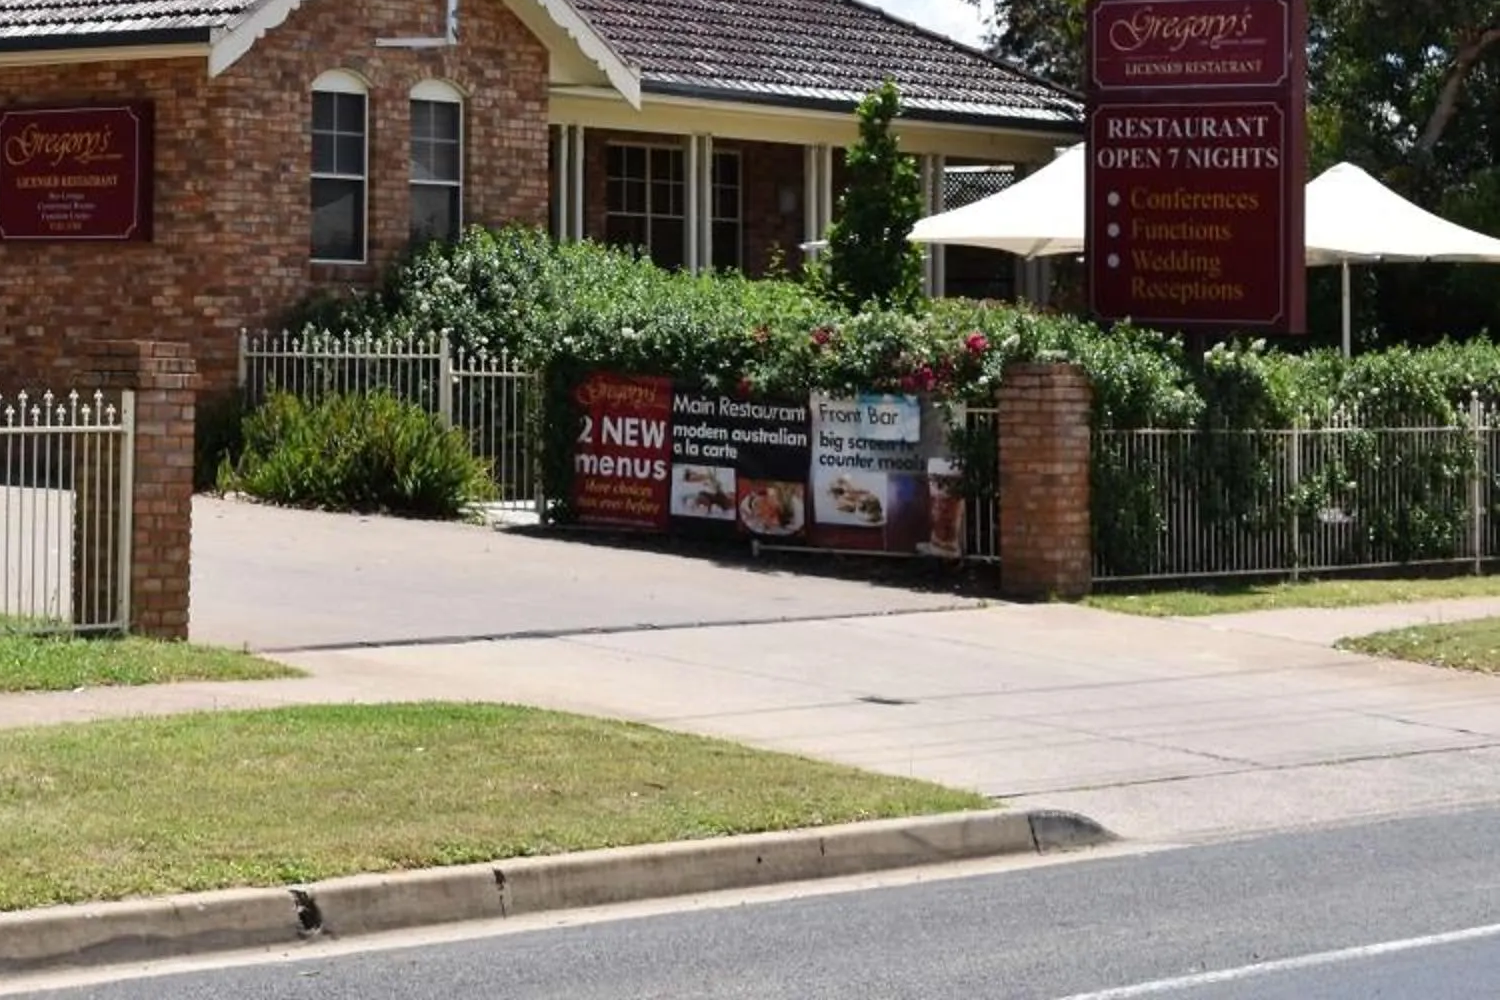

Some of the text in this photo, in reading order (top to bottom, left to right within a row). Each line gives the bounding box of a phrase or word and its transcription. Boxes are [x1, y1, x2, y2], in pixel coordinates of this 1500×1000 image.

[1109, 6, 1254, 52] Gregory's
[1125, 61, 1183, 76] LICENSED
[1185, 59, 1263, 75] RESTAURANT
[1107, 116, 1269, 140] RESTAURANT
[5, 122, 114, 167] Gregory's
[1097, 147, 1280, 170] OPEN 7 NIGHTS
[1130, 186, 1260, 210] Conferences
[1131, 217, 1233, 241] Functions
[1131, 249, 1222, 279] Wedding
[1131, 276, 1245, 305] Receptions
[673, 393, 806, 422] Main Restaurant
[819, 403, 899, 425] Front Bar
[577, 414, 667, 449] 2 NEW
[673, 421, 808, 447] modern australian
[819, 431, 844, 452] big
[847, 435, 897, 451] screen
[673, 438, 739, 459] a la carte
[574, 453, 668, 481] menus
[819, 453, 926, 471] counter meals
